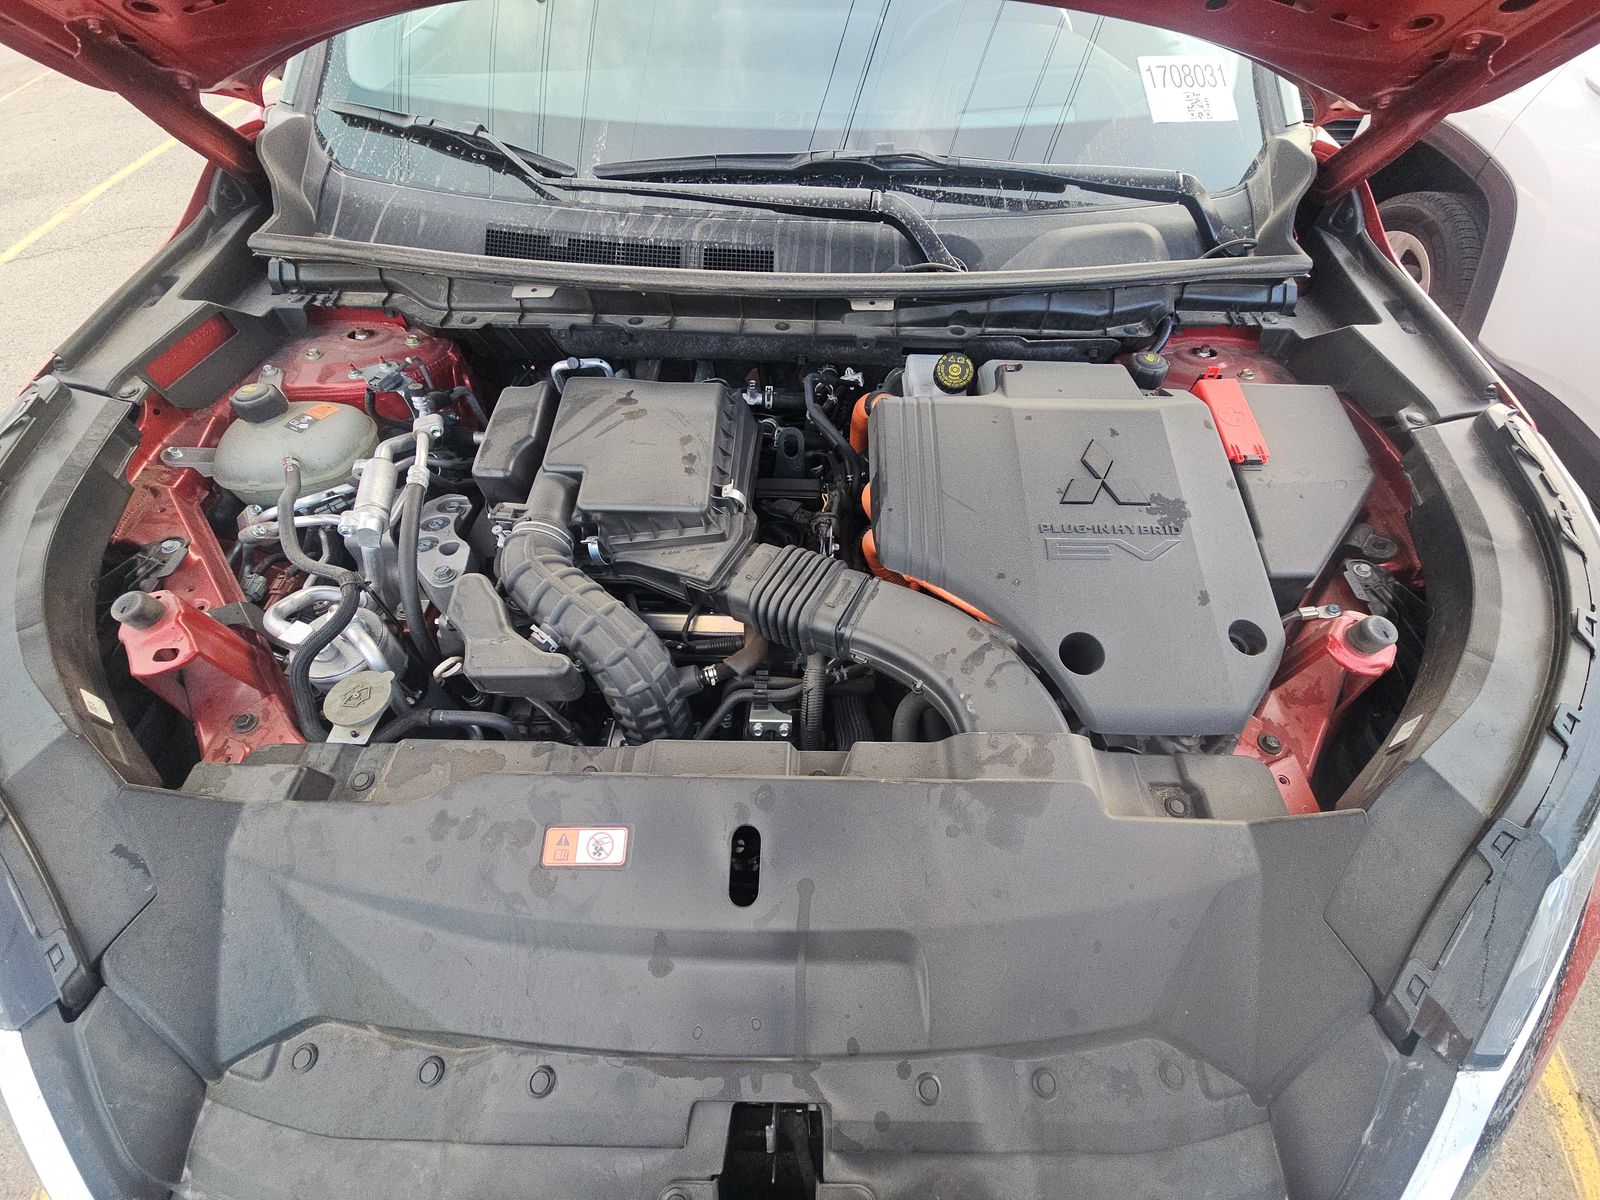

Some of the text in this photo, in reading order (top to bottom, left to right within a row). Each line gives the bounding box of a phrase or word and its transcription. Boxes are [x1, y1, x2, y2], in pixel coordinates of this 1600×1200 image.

[1145, 64, 1227, 88] 1708031
[1038, 523, 1182, 536] PLUG-IN HYBRID
[1044, 537, 1183, 562] EV
